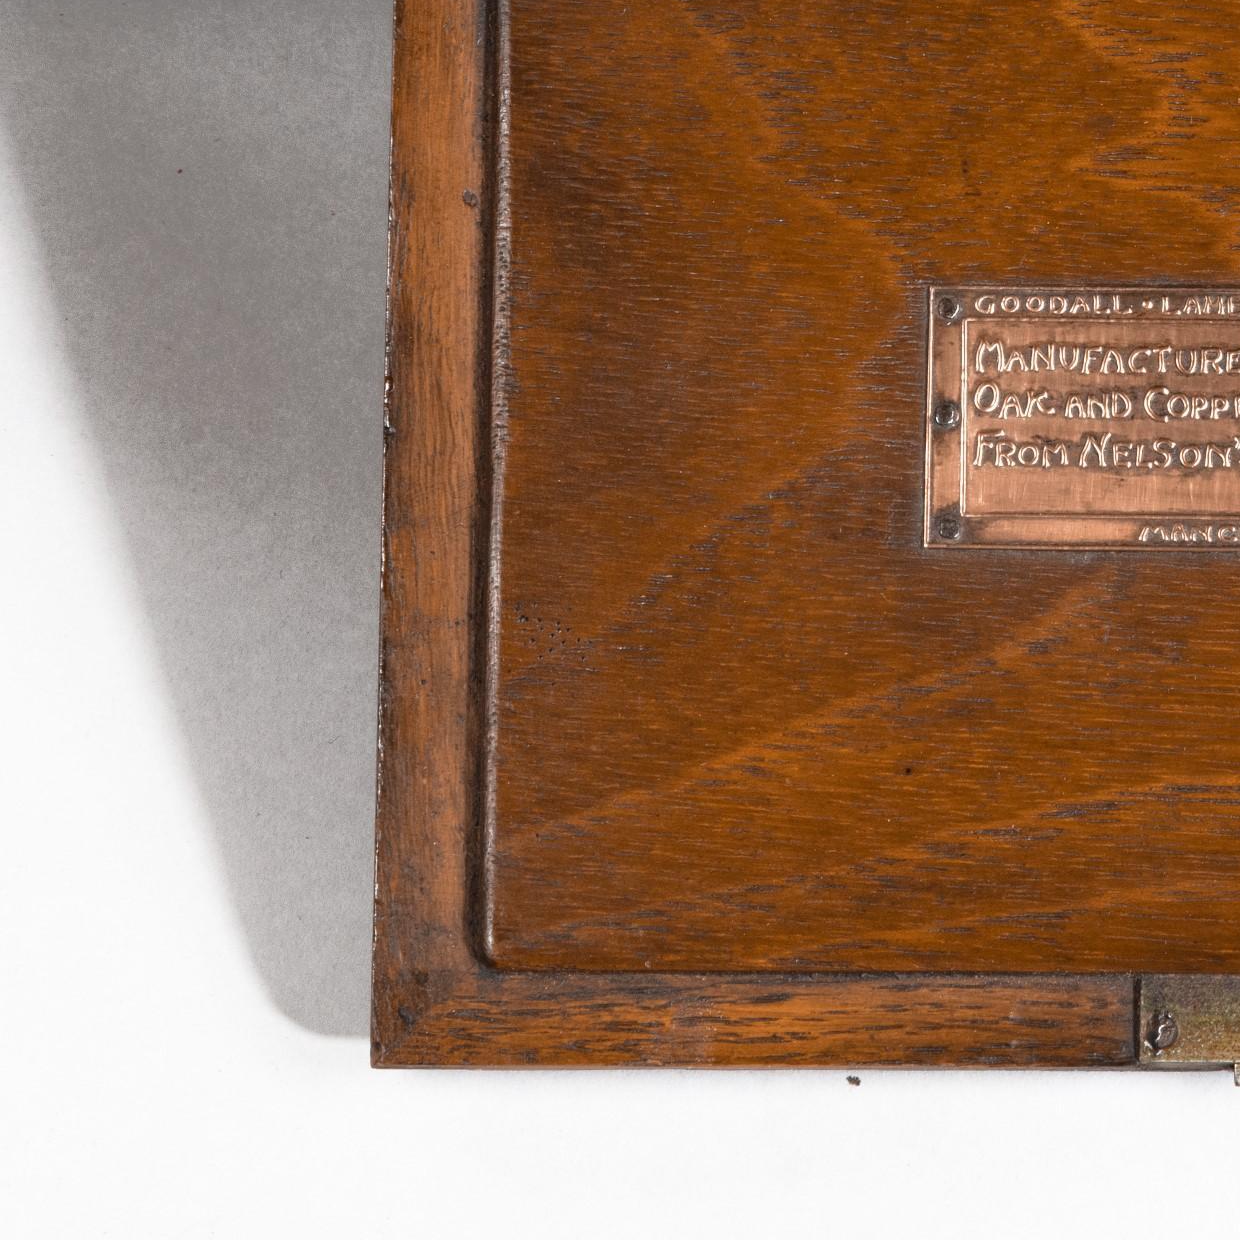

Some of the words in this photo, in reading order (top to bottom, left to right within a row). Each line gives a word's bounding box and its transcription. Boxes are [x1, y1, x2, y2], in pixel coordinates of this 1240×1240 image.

[974, 294, 1133, 315] GOODALL
[973, 380, 1056, 420] OAK
[1064, 391, 1133, 419] AND
[972, 429, 1069, 469] FROM
